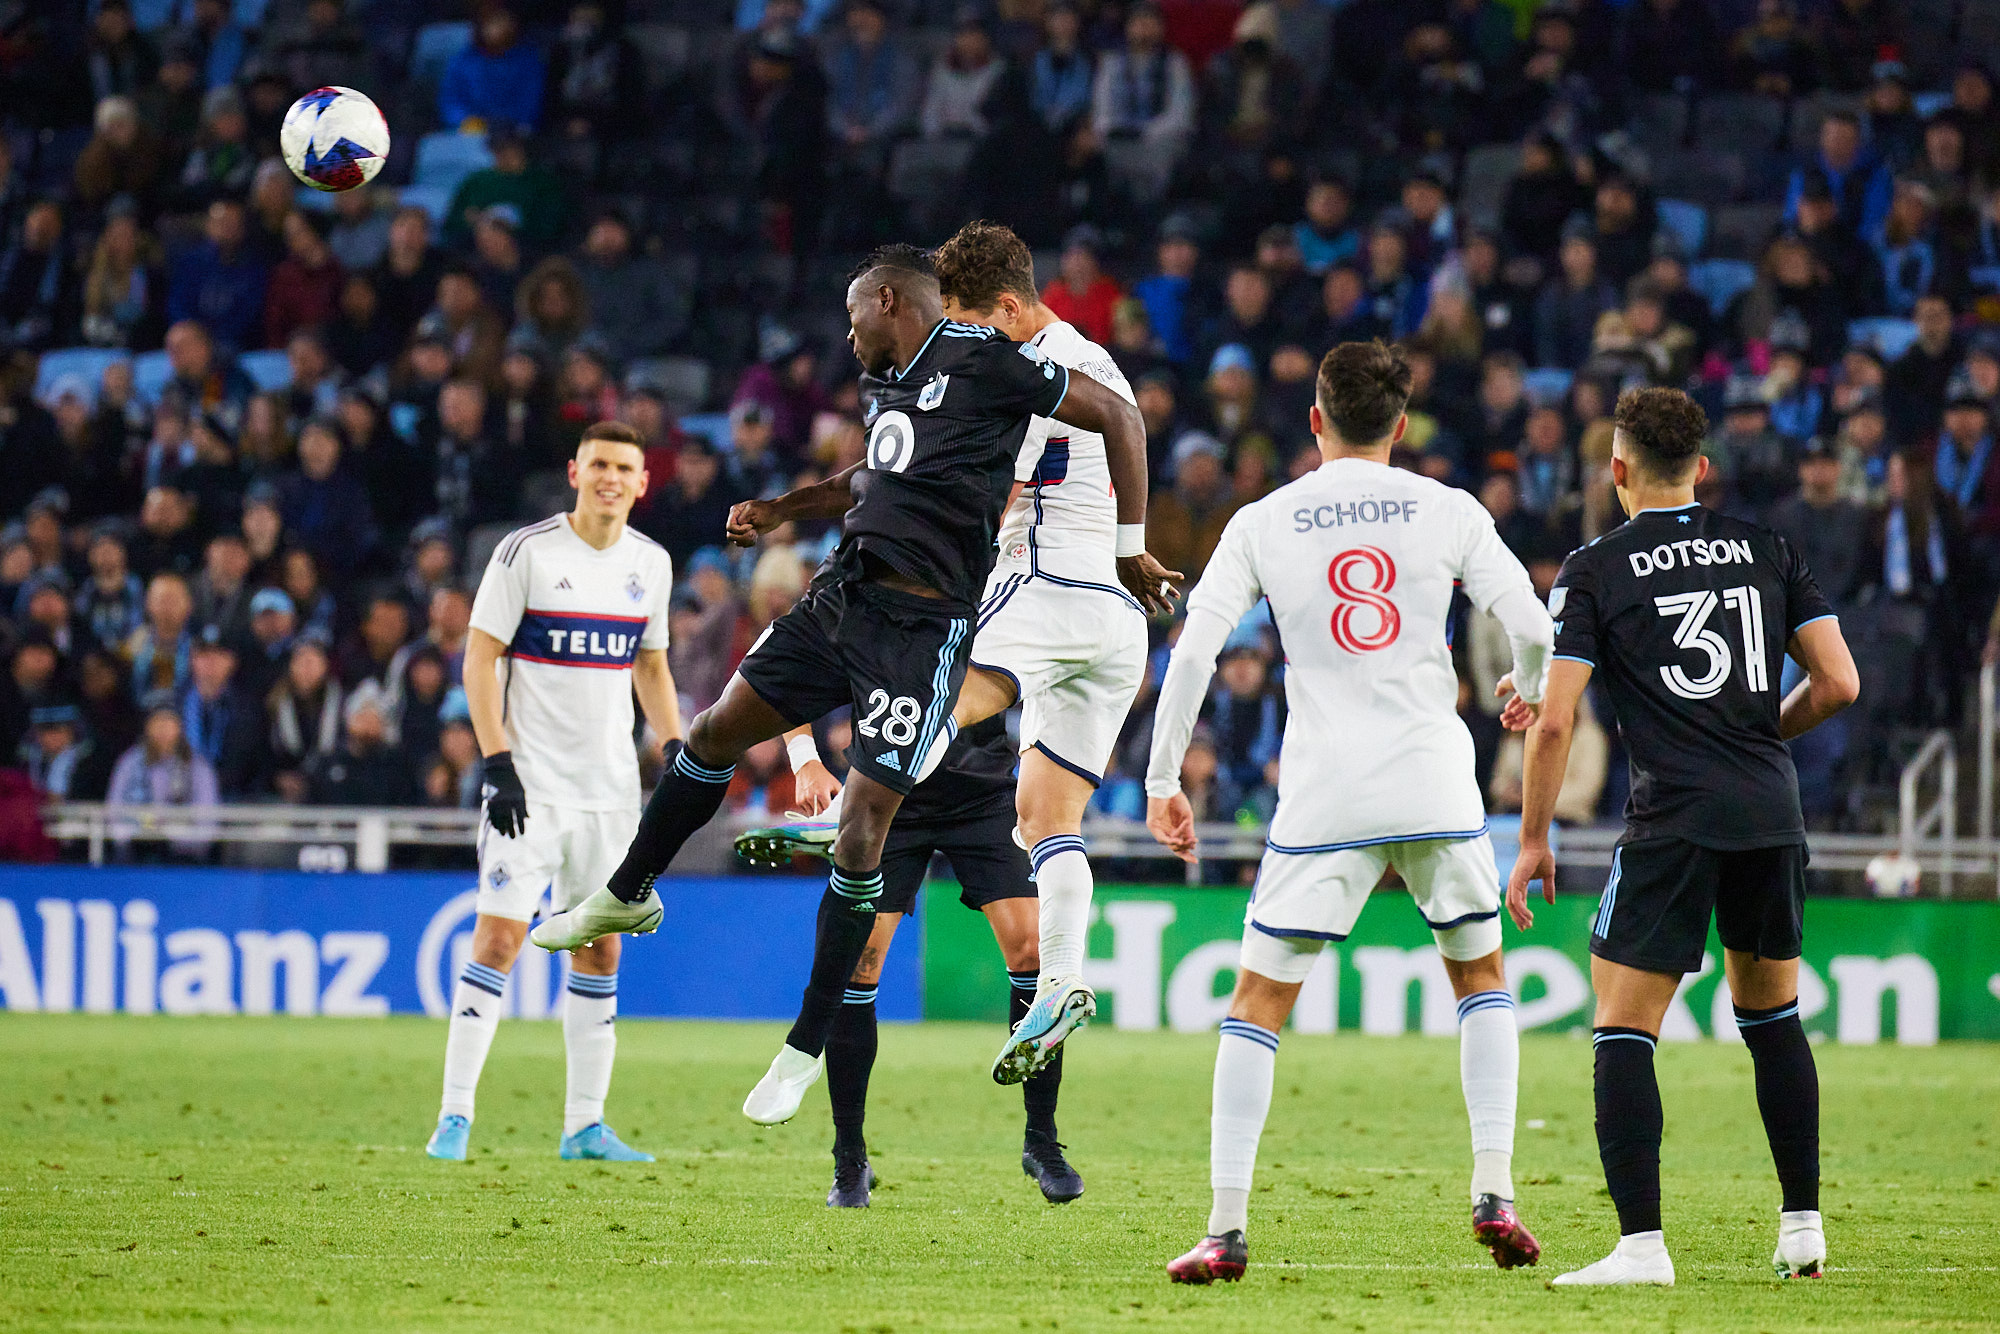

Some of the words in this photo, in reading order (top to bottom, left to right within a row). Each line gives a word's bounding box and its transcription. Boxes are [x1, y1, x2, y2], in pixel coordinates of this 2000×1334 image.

[1293, 493, 1418, 533] SCHÖPF
[1327, 543, 1401, 657] 8
[1628, 538, 1754, 577] DOTSON
[1653, 585, 1769, 700] 31
[857, 688, 922, 746] 28
[1083, 900, 1940, 1046] Henen
